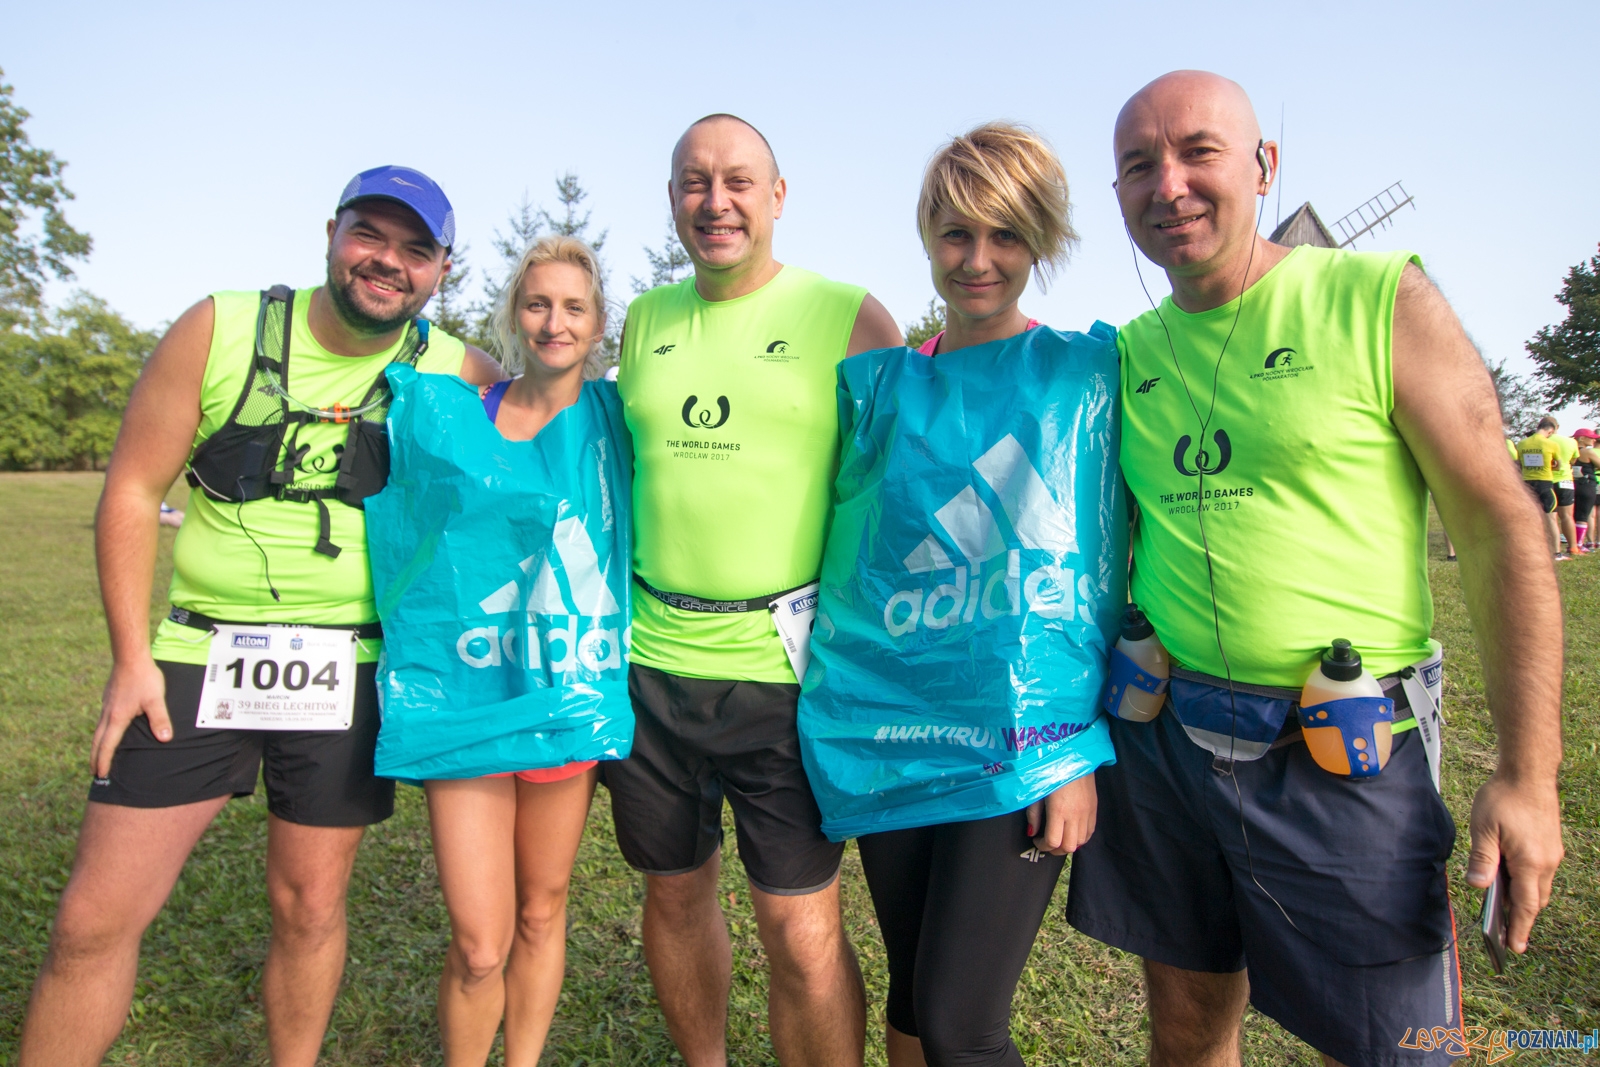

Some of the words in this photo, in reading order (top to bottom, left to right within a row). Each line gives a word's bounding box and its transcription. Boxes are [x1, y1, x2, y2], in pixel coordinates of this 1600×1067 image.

[653, 344, 676, 355] 4F
[1135, 376, 1162, 394] 4F
[666, 440, 680, 448] THE
[681, 440, 710, 449] WORLD
[711, 442, 741, 451] GAMES
[673, 451, 709, 460] WROCŁAW
[710, 453, 730, 461] 2017
[1160, 494, 1174, 504] THE
[1214, 487, 1254, 498] GAMES
[1214, 501, 1240, 512] 2017
[884, 549, 1098, 638] adidas
[680, 600, 748, 612] GRANICE
[226, 658, 340, 691] 1004
[237, 700, 251, 709] 39
[254, 701, 280, 710] BIEG
